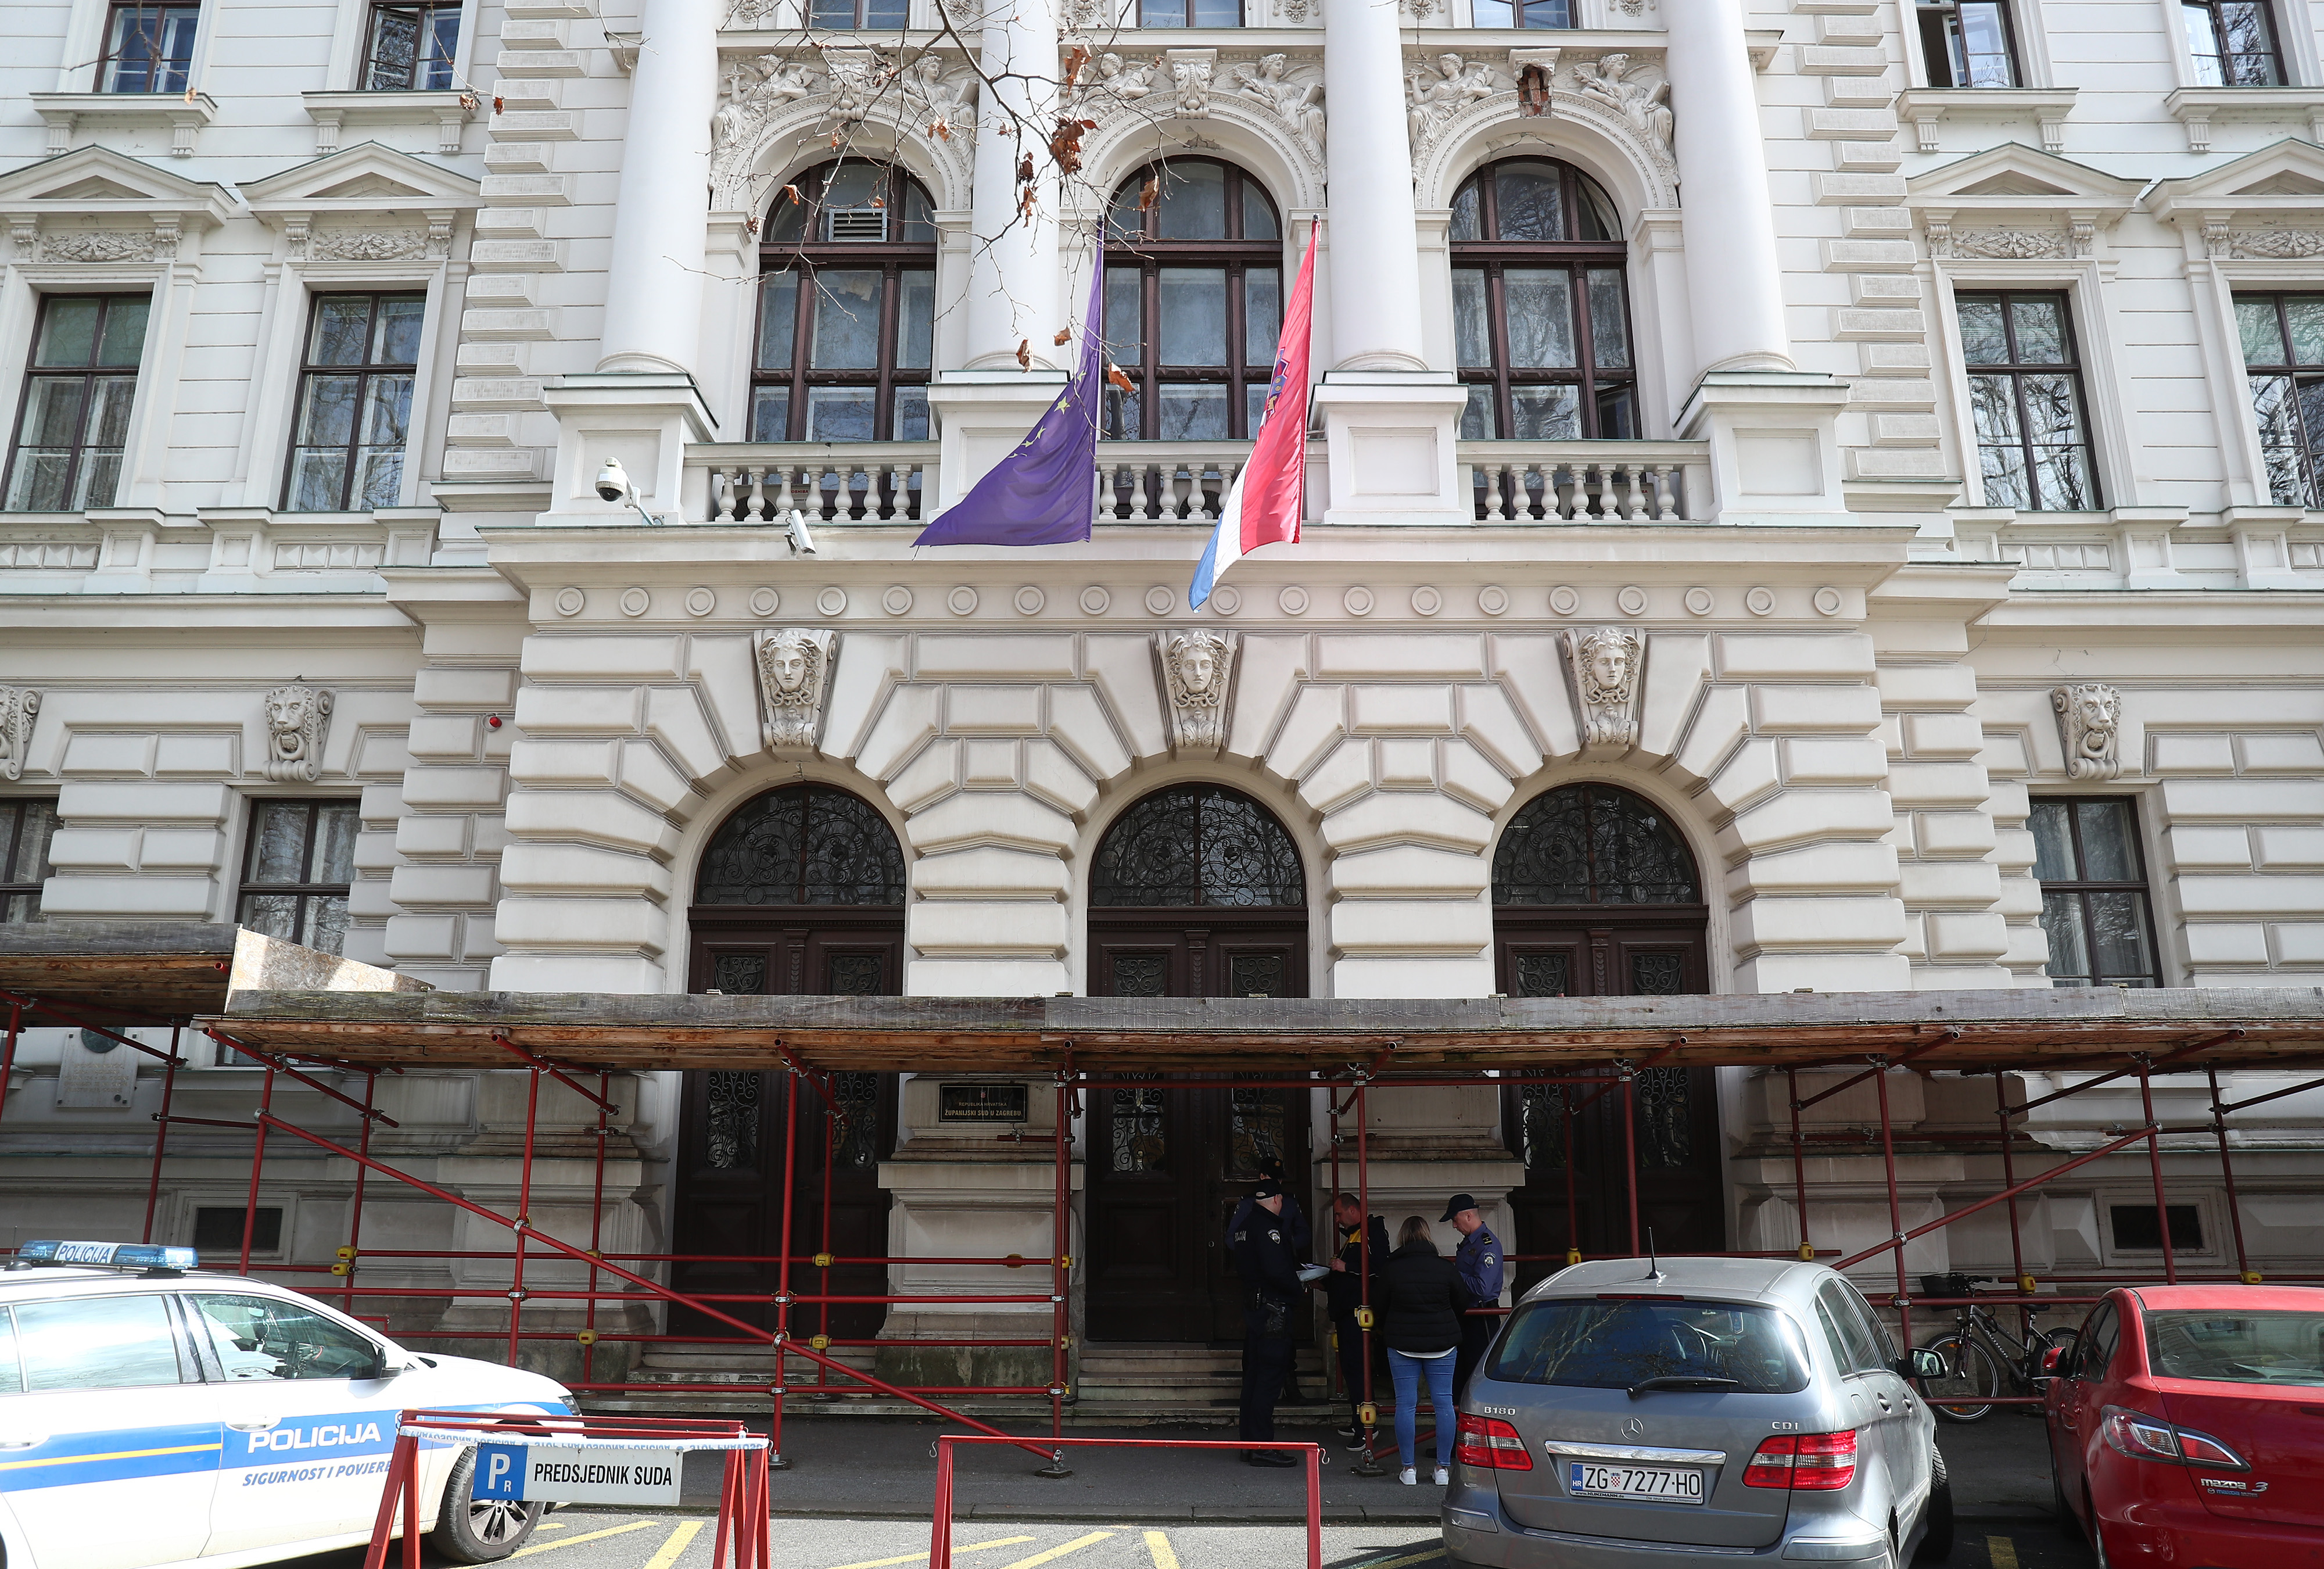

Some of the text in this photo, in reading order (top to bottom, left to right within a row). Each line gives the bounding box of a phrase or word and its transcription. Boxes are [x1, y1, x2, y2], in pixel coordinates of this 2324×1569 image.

[58, 1245, 111, 1263] POLICIJA
[1985, 1330, 2009, 1359] AUTHOR
[1484, 1406, 1516, 1416] B180
[1772, 1421, 1798, 1430] CDI
[248, 1422, 382, 1453] POLICIJA
[242, 1467, 326, 1486] SIGURNOST
[327, 1466, 334, 1478] I
[487, 1453, 512, 1492] P R
[534, 1463, 672, 1486] PREDSJEDNIK SUDA
[1585, 1467, 1608, 1489] ZG
[2251, 1481, 2268, 1492] 3
